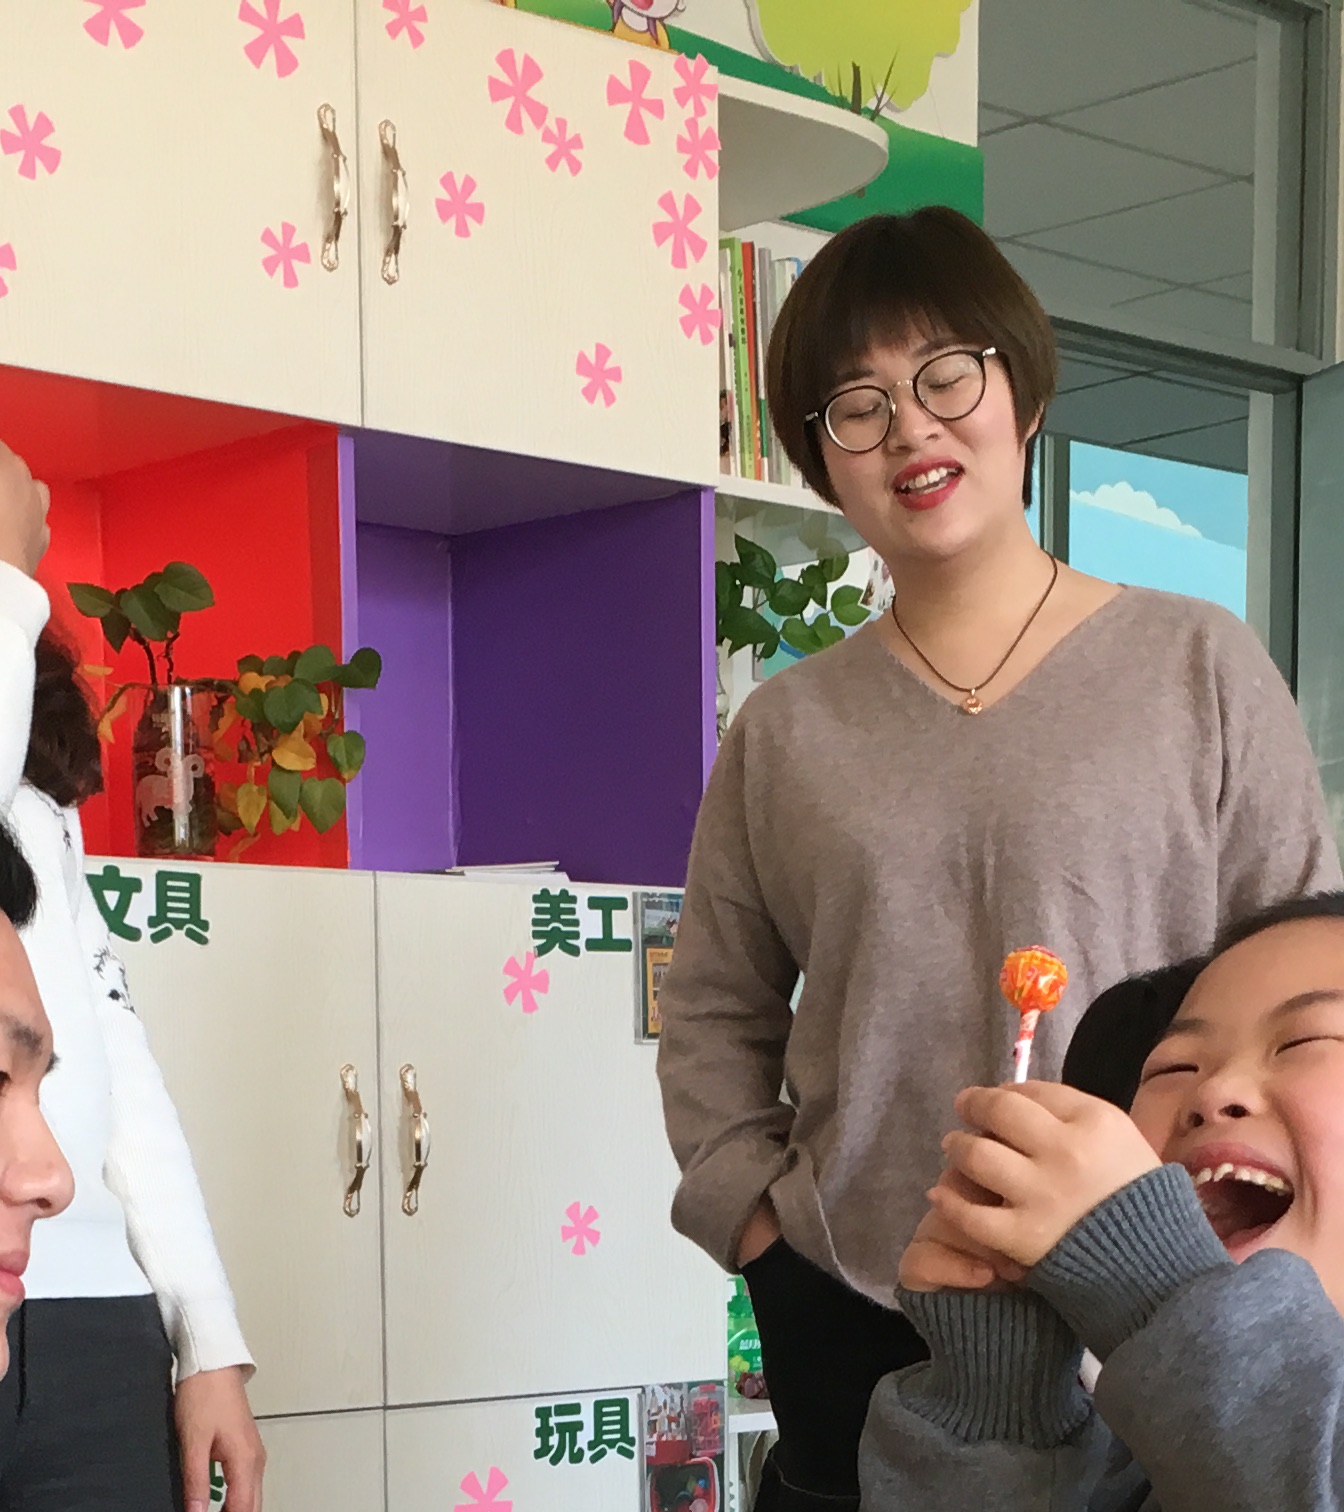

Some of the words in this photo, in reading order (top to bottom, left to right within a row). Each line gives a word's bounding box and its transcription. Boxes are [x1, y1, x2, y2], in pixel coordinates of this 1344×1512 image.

[85, 864, 209, 945] 文具
[531, 888, 632, 958] 美工
[533, 1397, 636, 1466] 玩具
